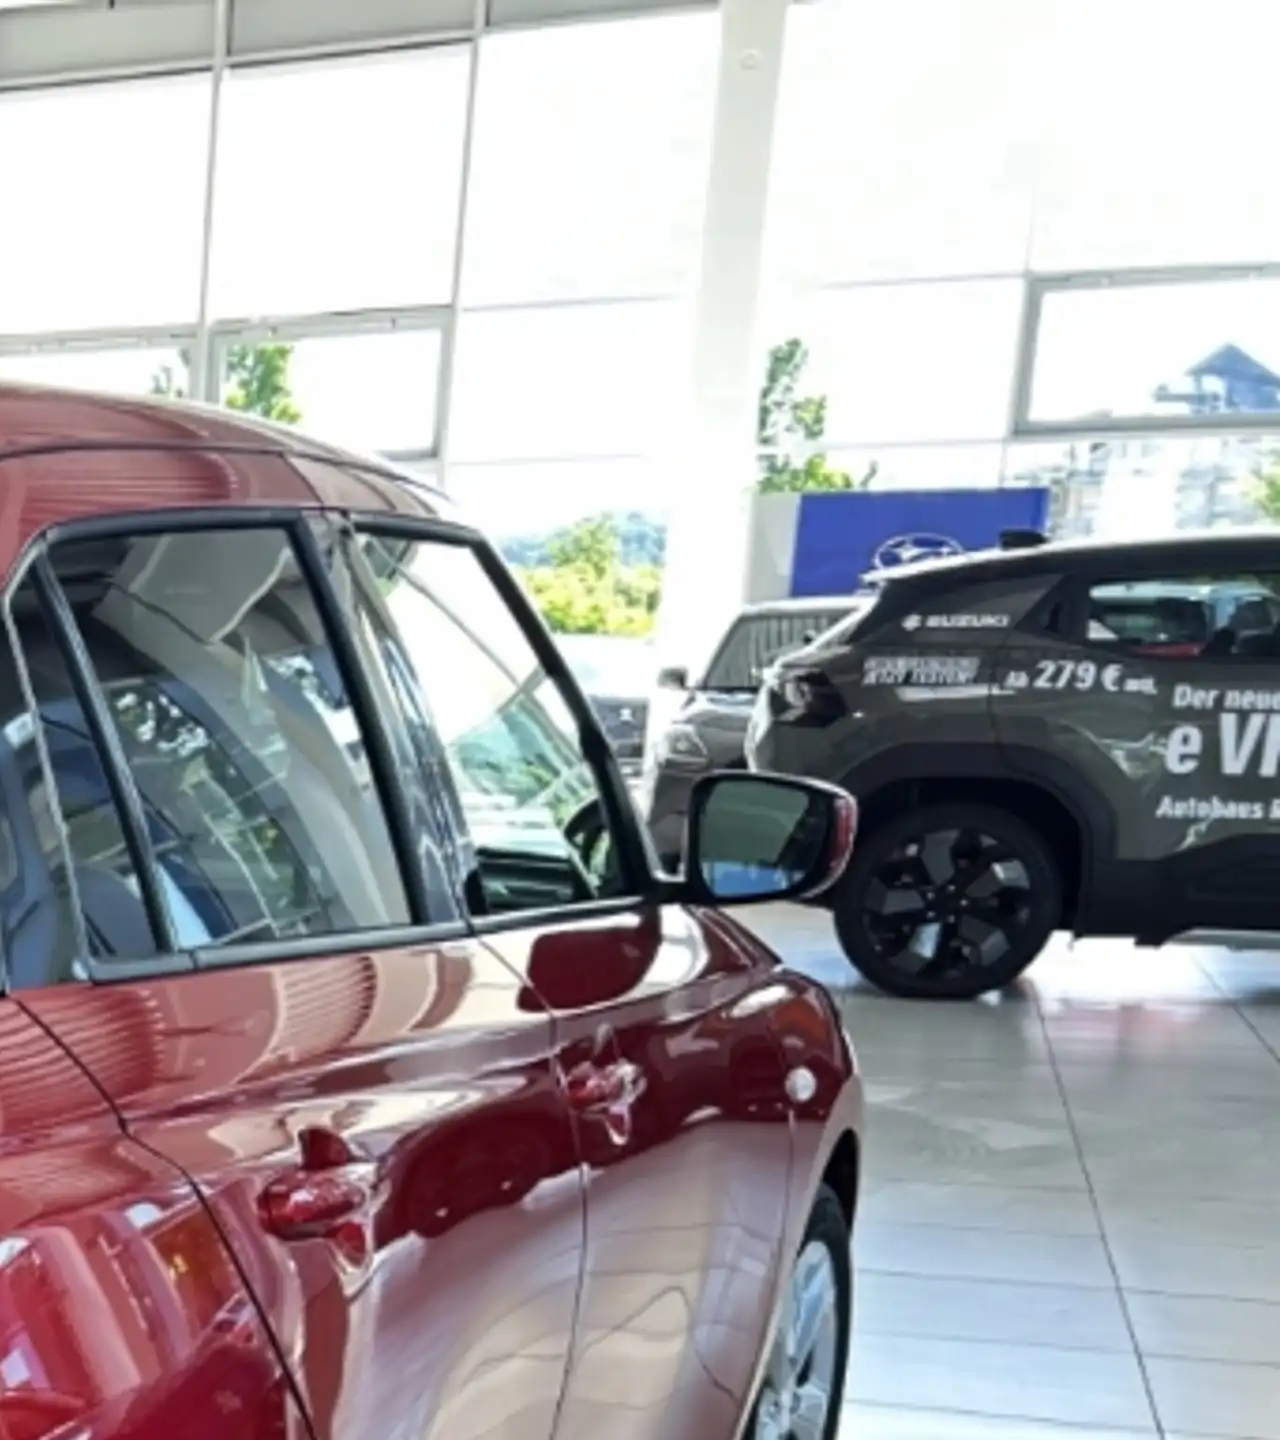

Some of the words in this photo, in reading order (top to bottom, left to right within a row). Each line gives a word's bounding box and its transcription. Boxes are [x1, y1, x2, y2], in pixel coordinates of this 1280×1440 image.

[924, 613, 1012, 628] SUZUKI
[1033, 660, 1098, 690] 279
[1100, 663, 1124, 692] €
[1171, 682, 1220, 709] Der
[1164, 723, 1203, 775] e
[1154, 796, 1264, 819] Autohaus
